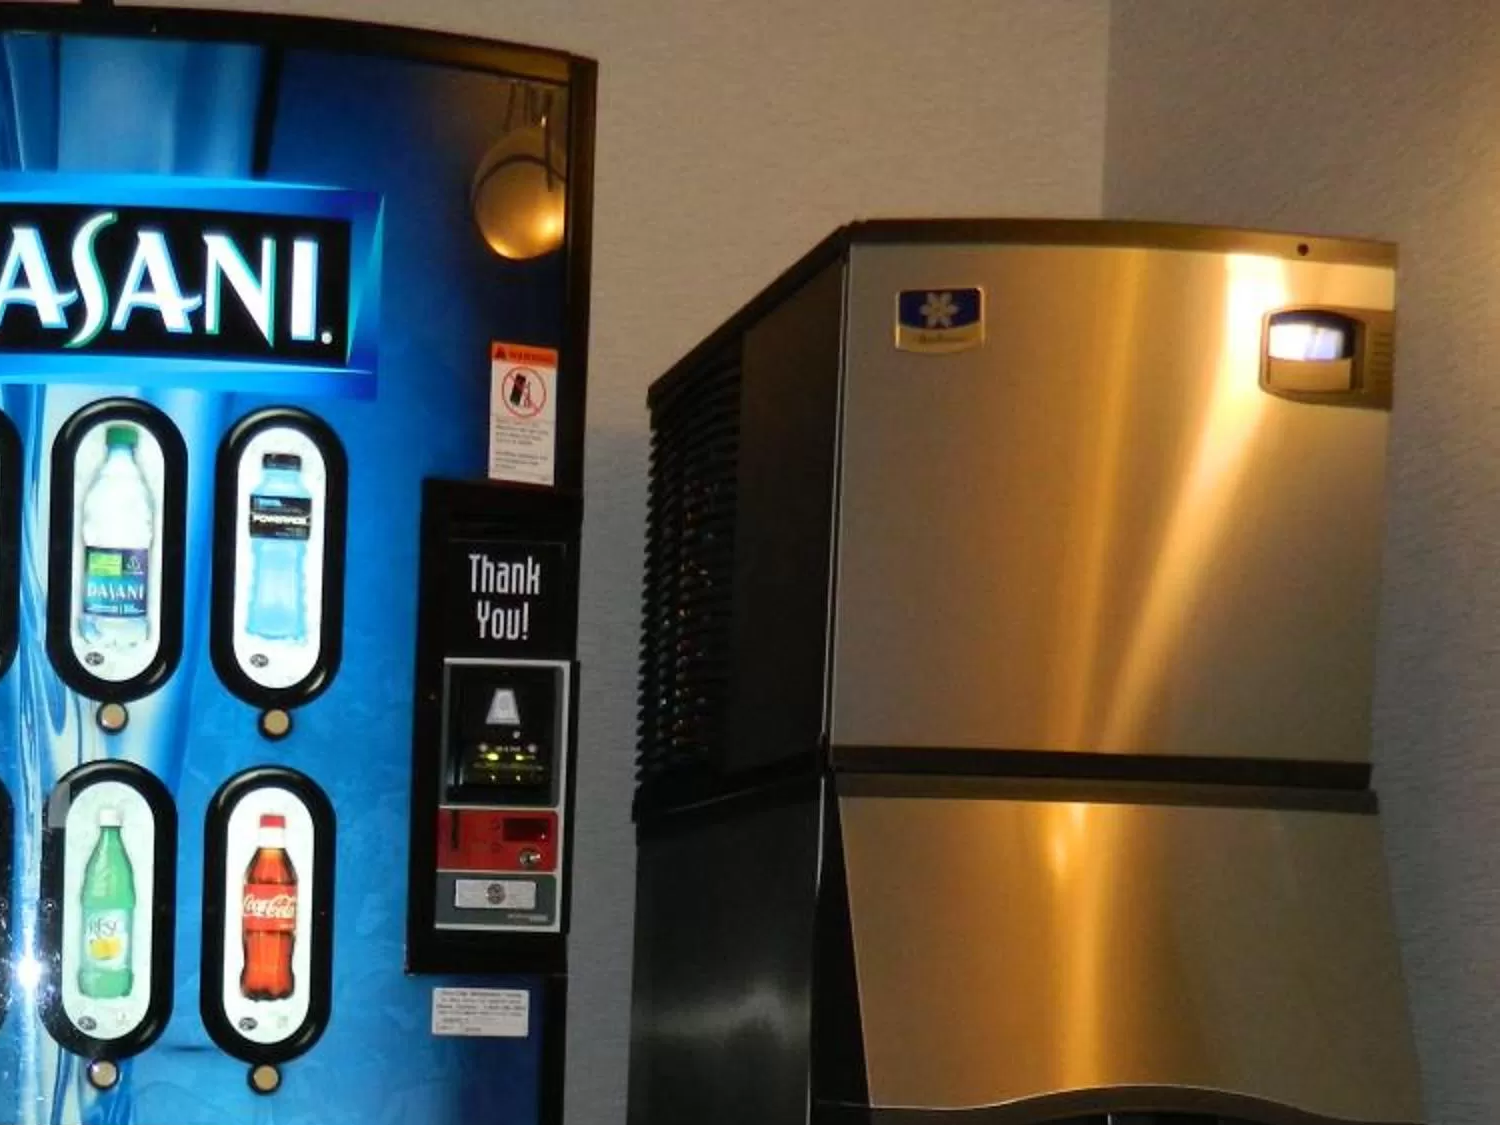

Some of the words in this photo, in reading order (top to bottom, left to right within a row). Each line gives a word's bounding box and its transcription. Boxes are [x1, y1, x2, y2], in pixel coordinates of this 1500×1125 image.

[86, 581, 145, 599] DASANI
[467, 553, 541, 595] Thank
[476, 599, 530, 641] You!
